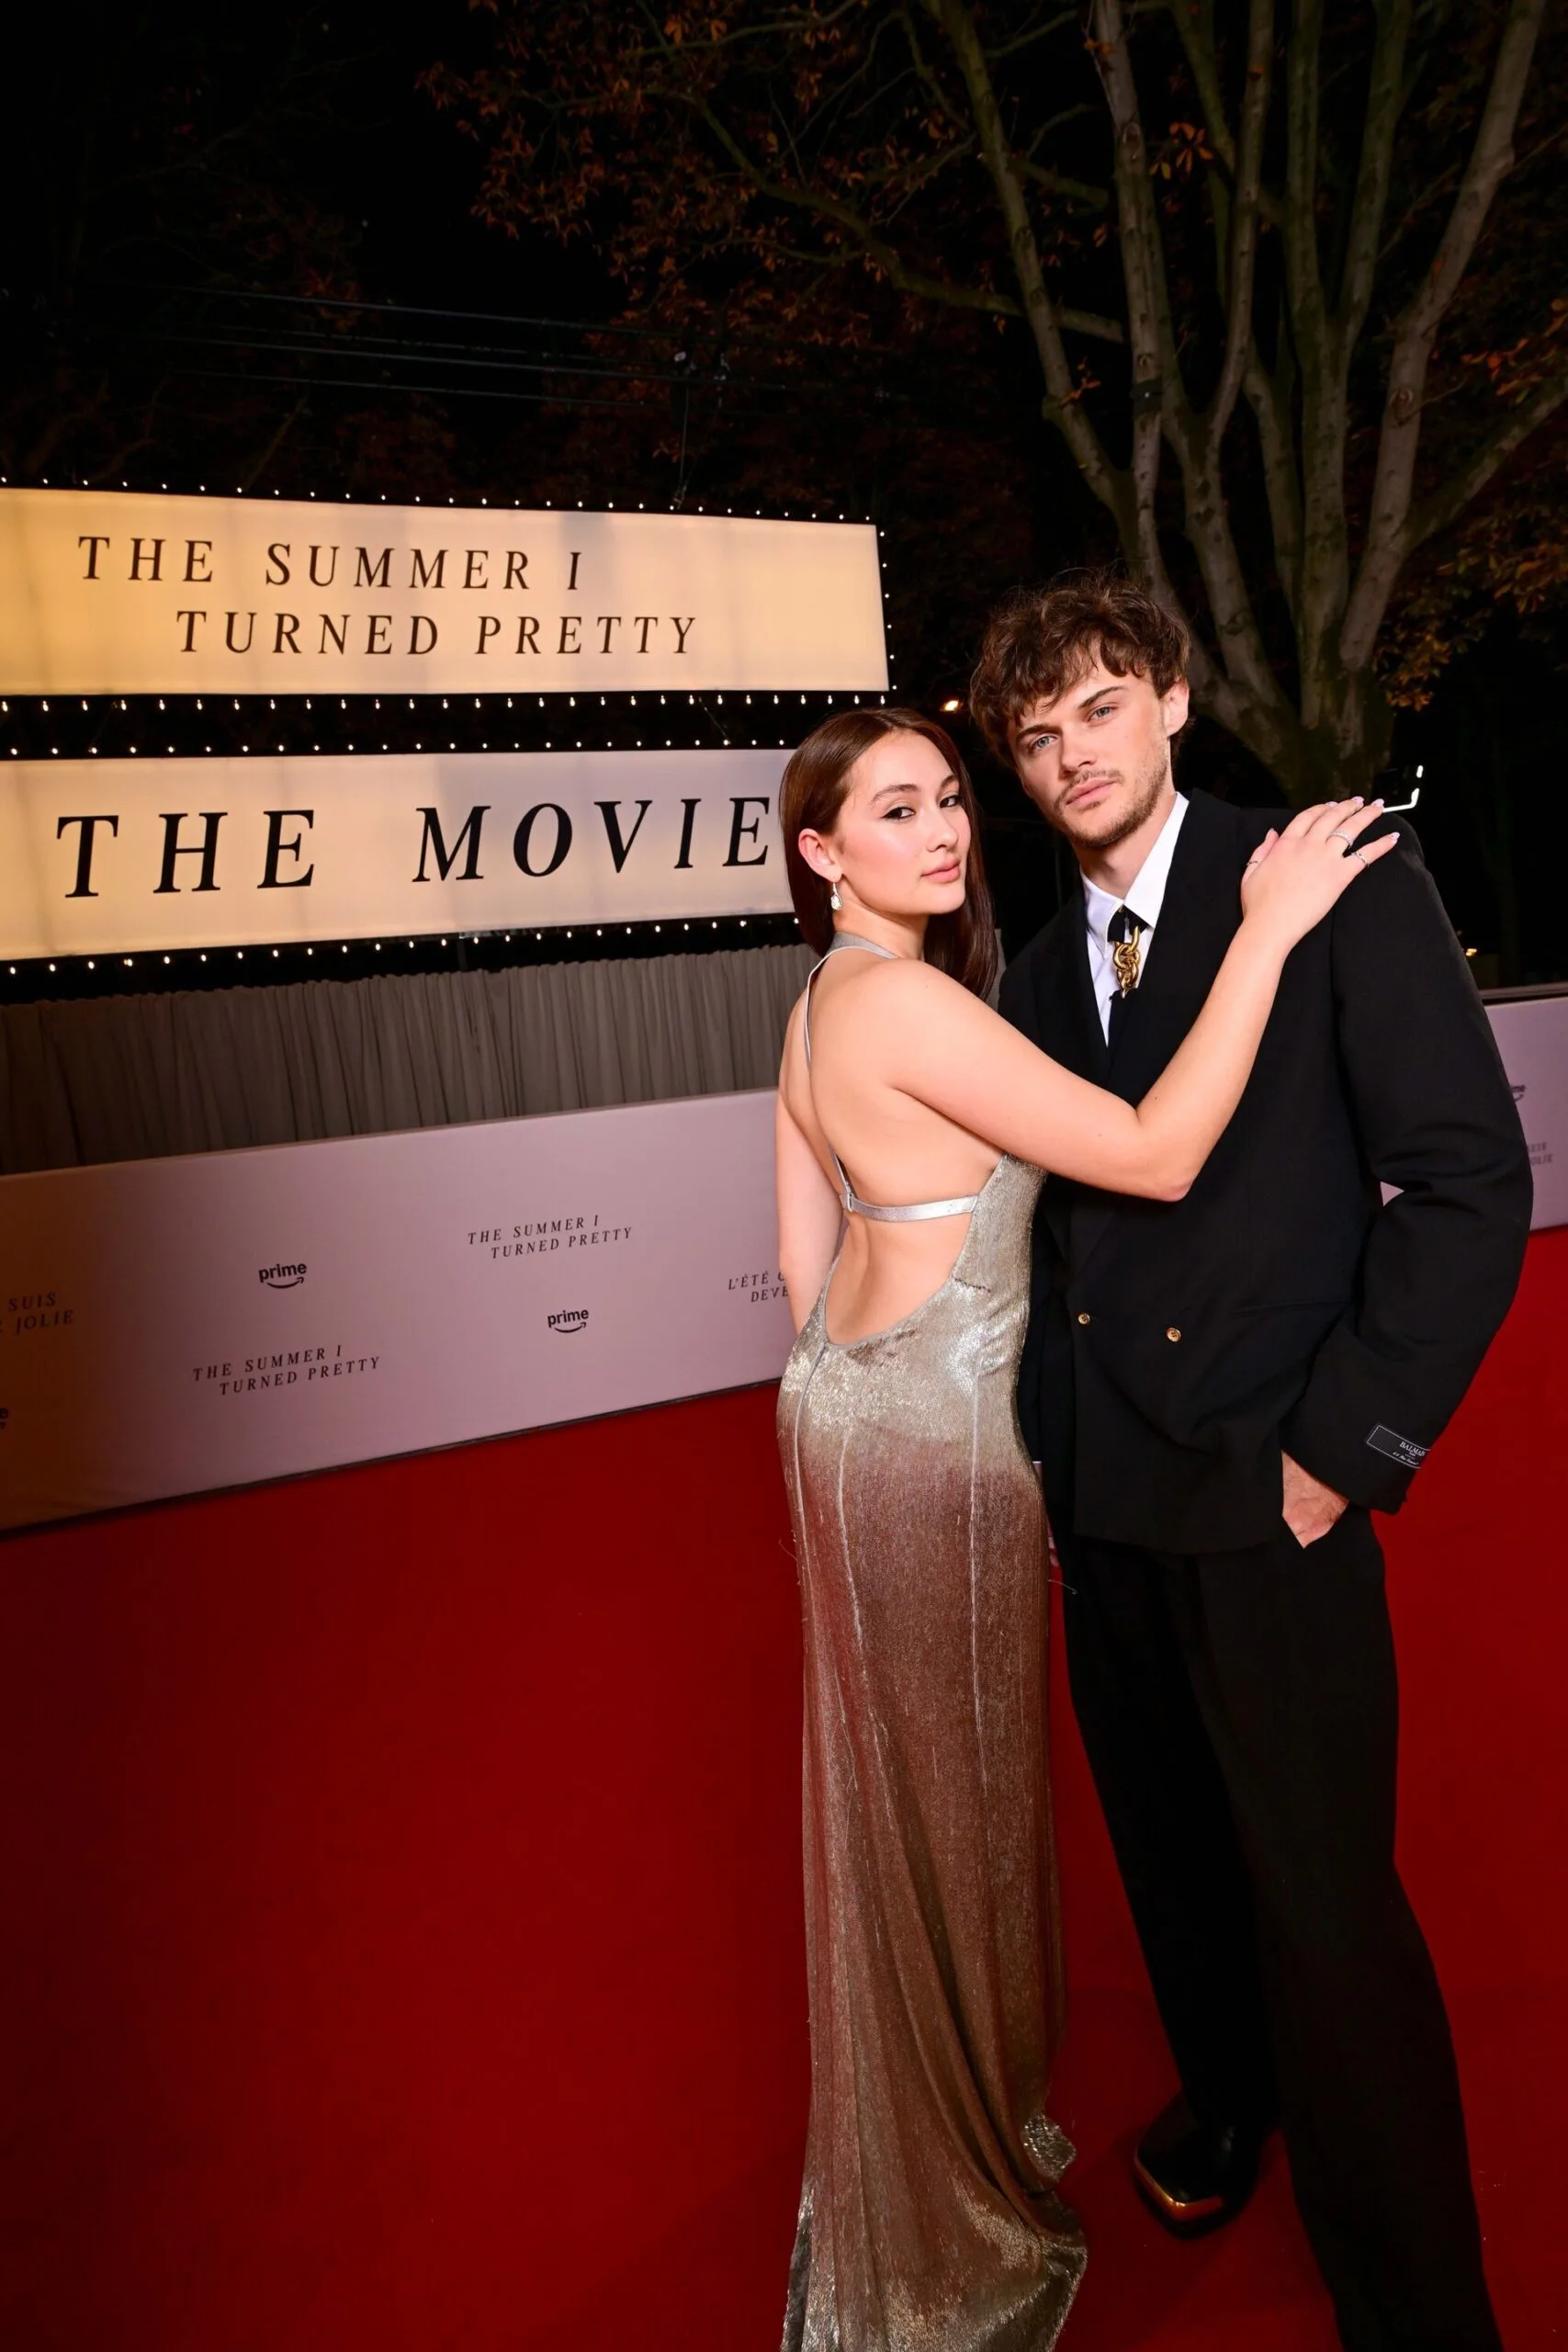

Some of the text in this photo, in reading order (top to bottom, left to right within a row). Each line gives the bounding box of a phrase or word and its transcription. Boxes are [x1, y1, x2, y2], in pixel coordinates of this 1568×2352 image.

[78, 536, 581, 591] THE SUMMER I
[176, 610, 696, 655] TURNED PRETTY
[56, 797, 770, 899] THE MOVIE
[468, 1214, 599, 1245] THE SUMMER I
[491, 1227, 632, 1260] TURNED PRETTY
[258, 1262, 308, 1283] prime
[728, 1270, 769, 1291] L'ÉTÉ
[7, 1292, 56, 1313] SUIS
[750, 1285, 789, 1303] DEVE
[16, 1309, 73, 1336] JOLIE
[547, 1309, 590, 1329] prime
[193, 1344, 342, 1382] THE SUMMER I
[220, 1356, 379, 1396] TURNED PRETTY
